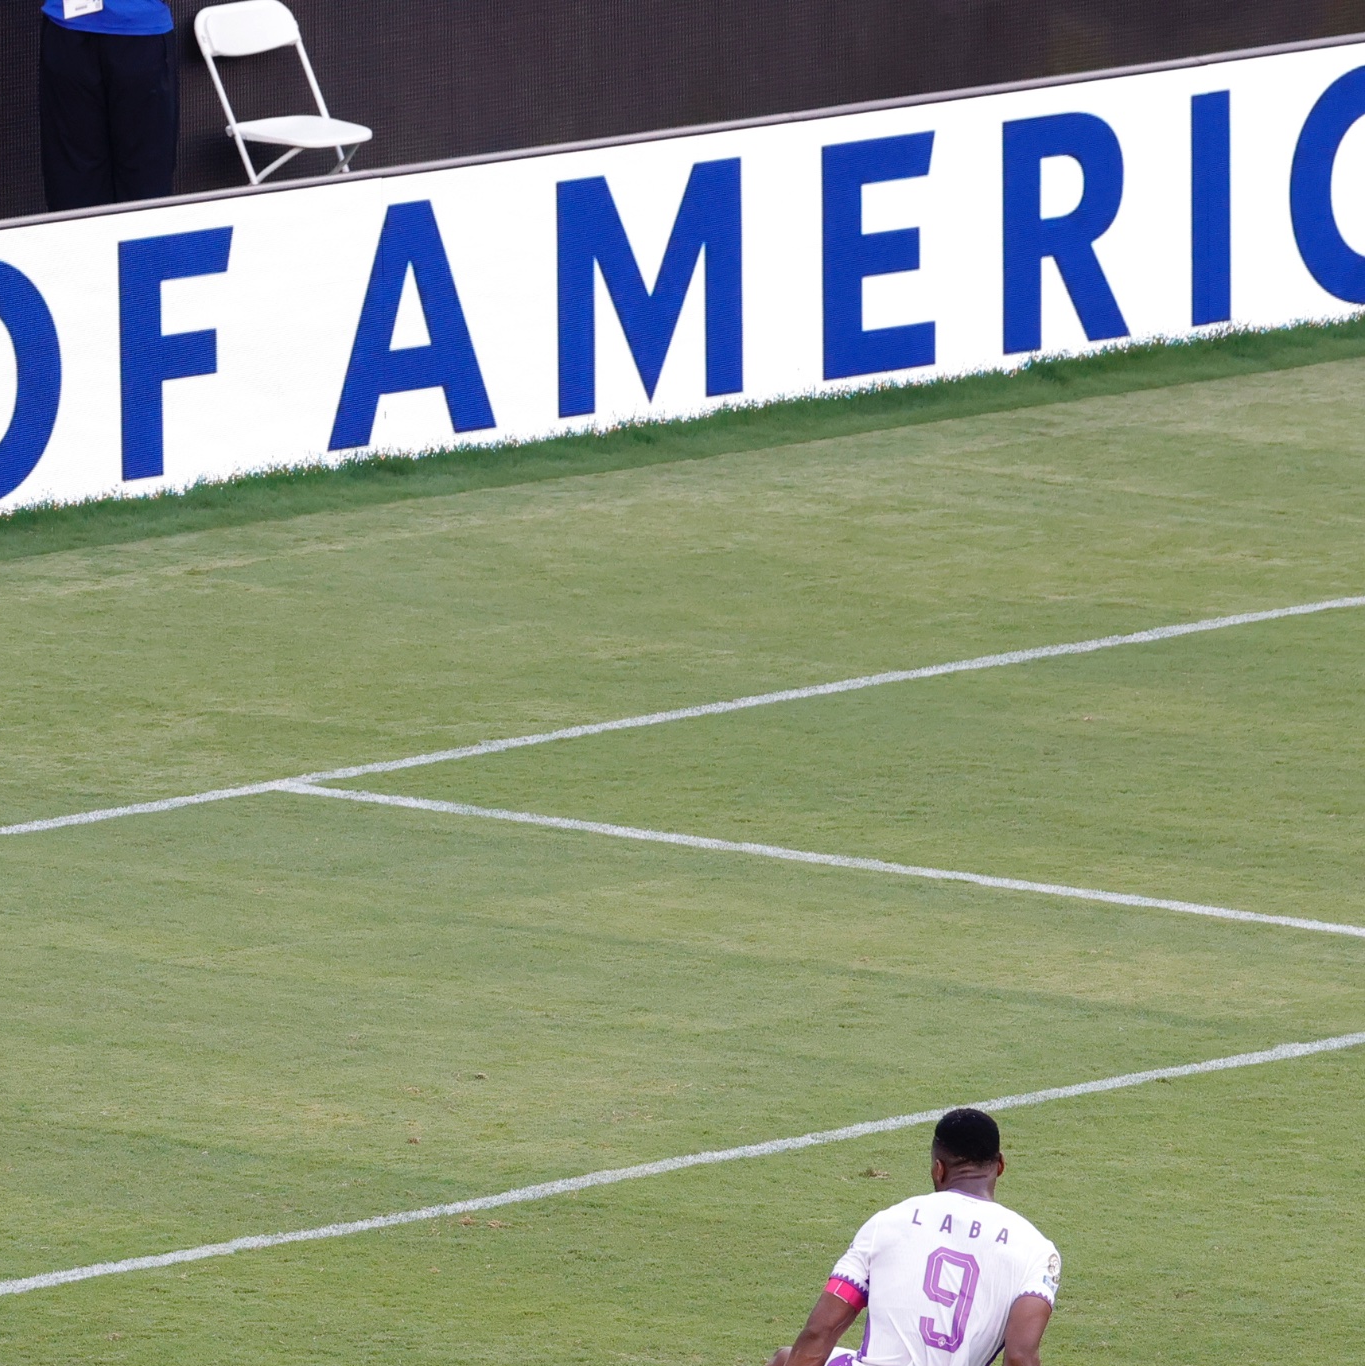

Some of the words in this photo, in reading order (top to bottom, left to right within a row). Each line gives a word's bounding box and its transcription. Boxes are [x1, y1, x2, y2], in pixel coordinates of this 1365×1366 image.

[328, 65, 1365, 452] AMERIC
[912, 1208, 1009, 1245] LABA
[919, 1246, 980, 1354] 9
